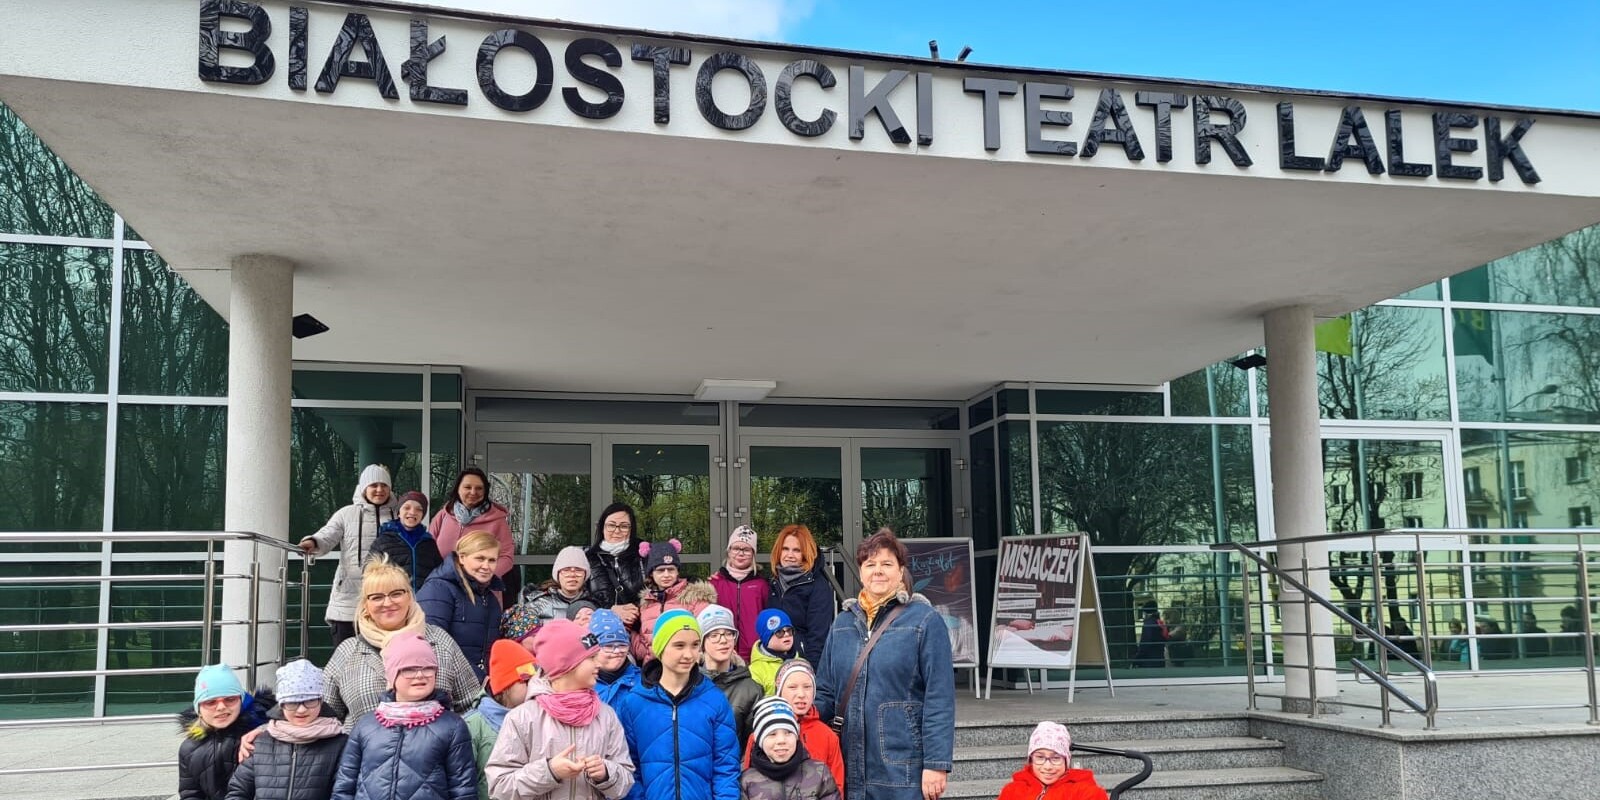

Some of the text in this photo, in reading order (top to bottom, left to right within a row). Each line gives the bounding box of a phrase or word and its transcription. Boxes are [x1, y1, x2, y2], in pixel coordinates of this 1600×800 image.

[198, 0, 1541, 184] BIAŁOSTOCKI TEATR LALEK
[1059, 537, 1078, 546] BTL
[1000, 543, 1079, 583] MISIACZEK
